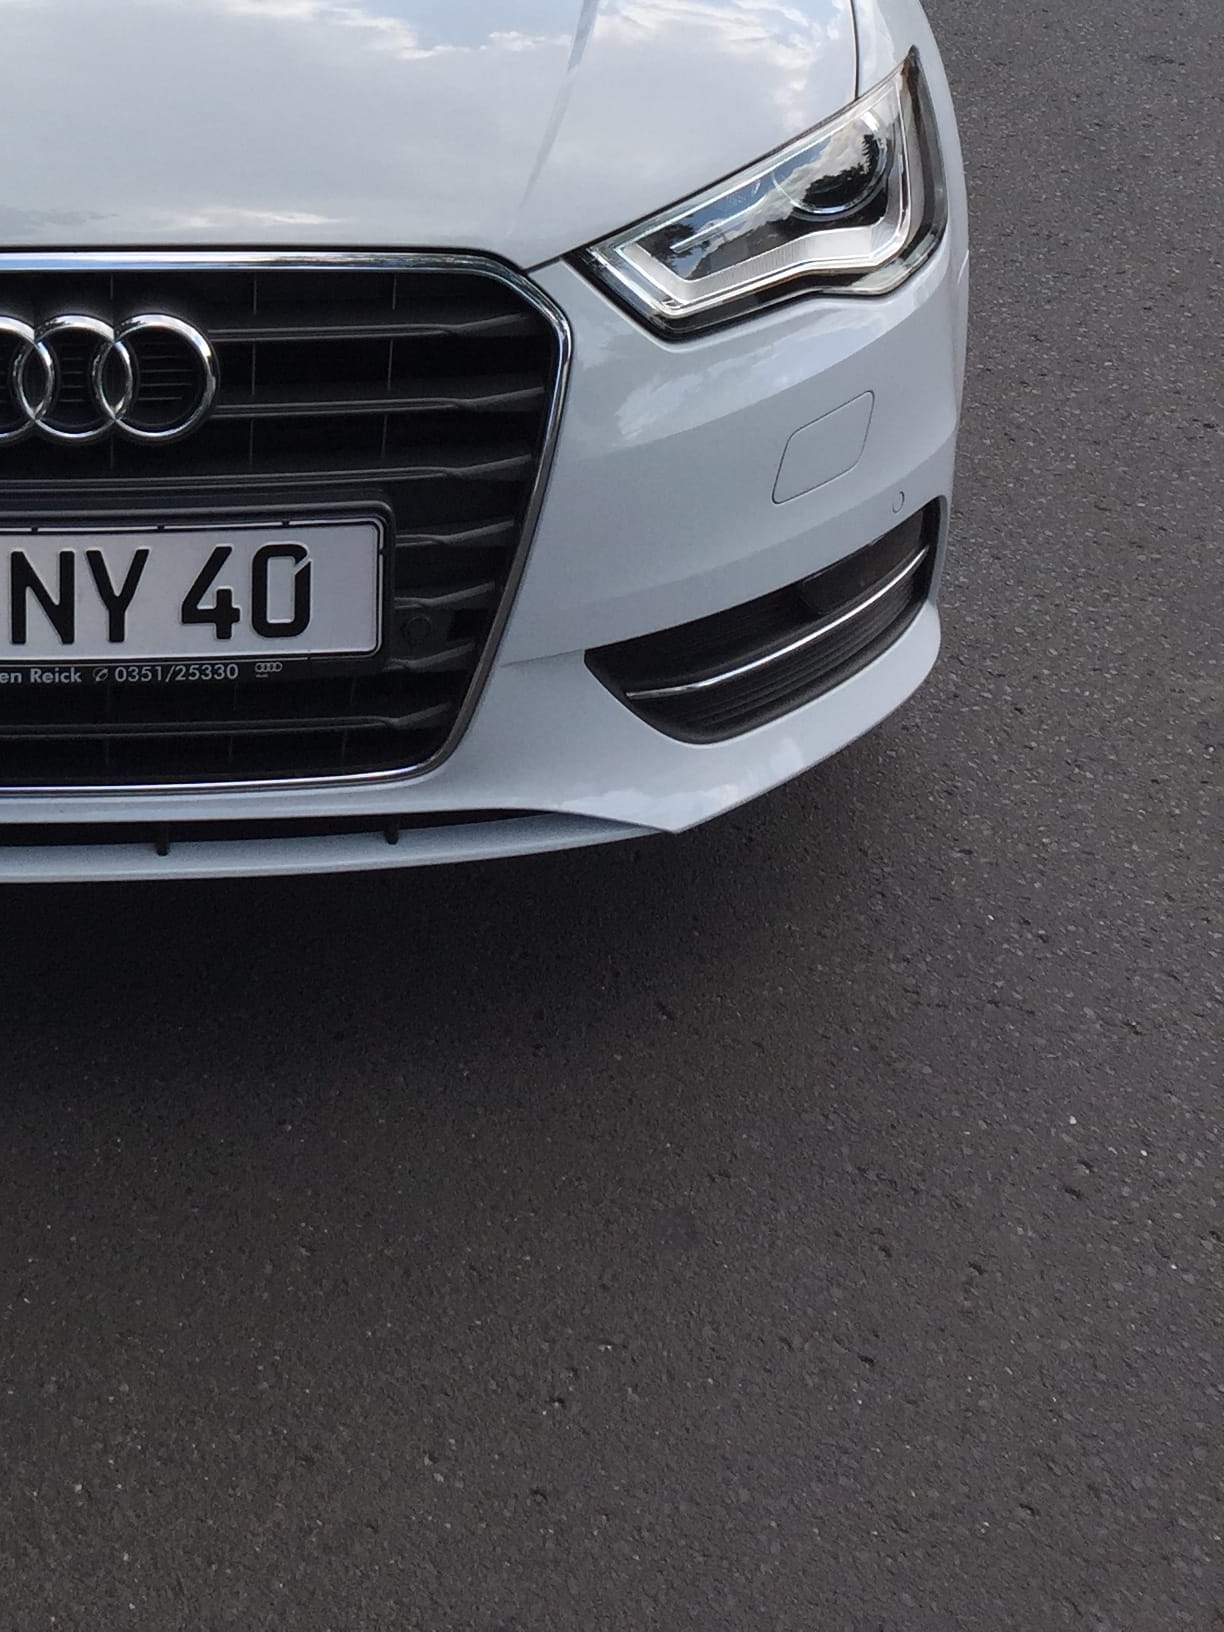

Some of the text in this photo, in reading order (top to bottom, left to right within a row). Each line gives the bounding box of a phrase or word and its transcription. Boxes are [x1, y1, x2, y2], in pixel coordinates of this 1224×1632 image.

[10, 548, 151, 644] NY
[181, 543, 312, 640] 40
[29, 666, 83, 684] Reick
[114, 663, 239, 683] 0351/25330
